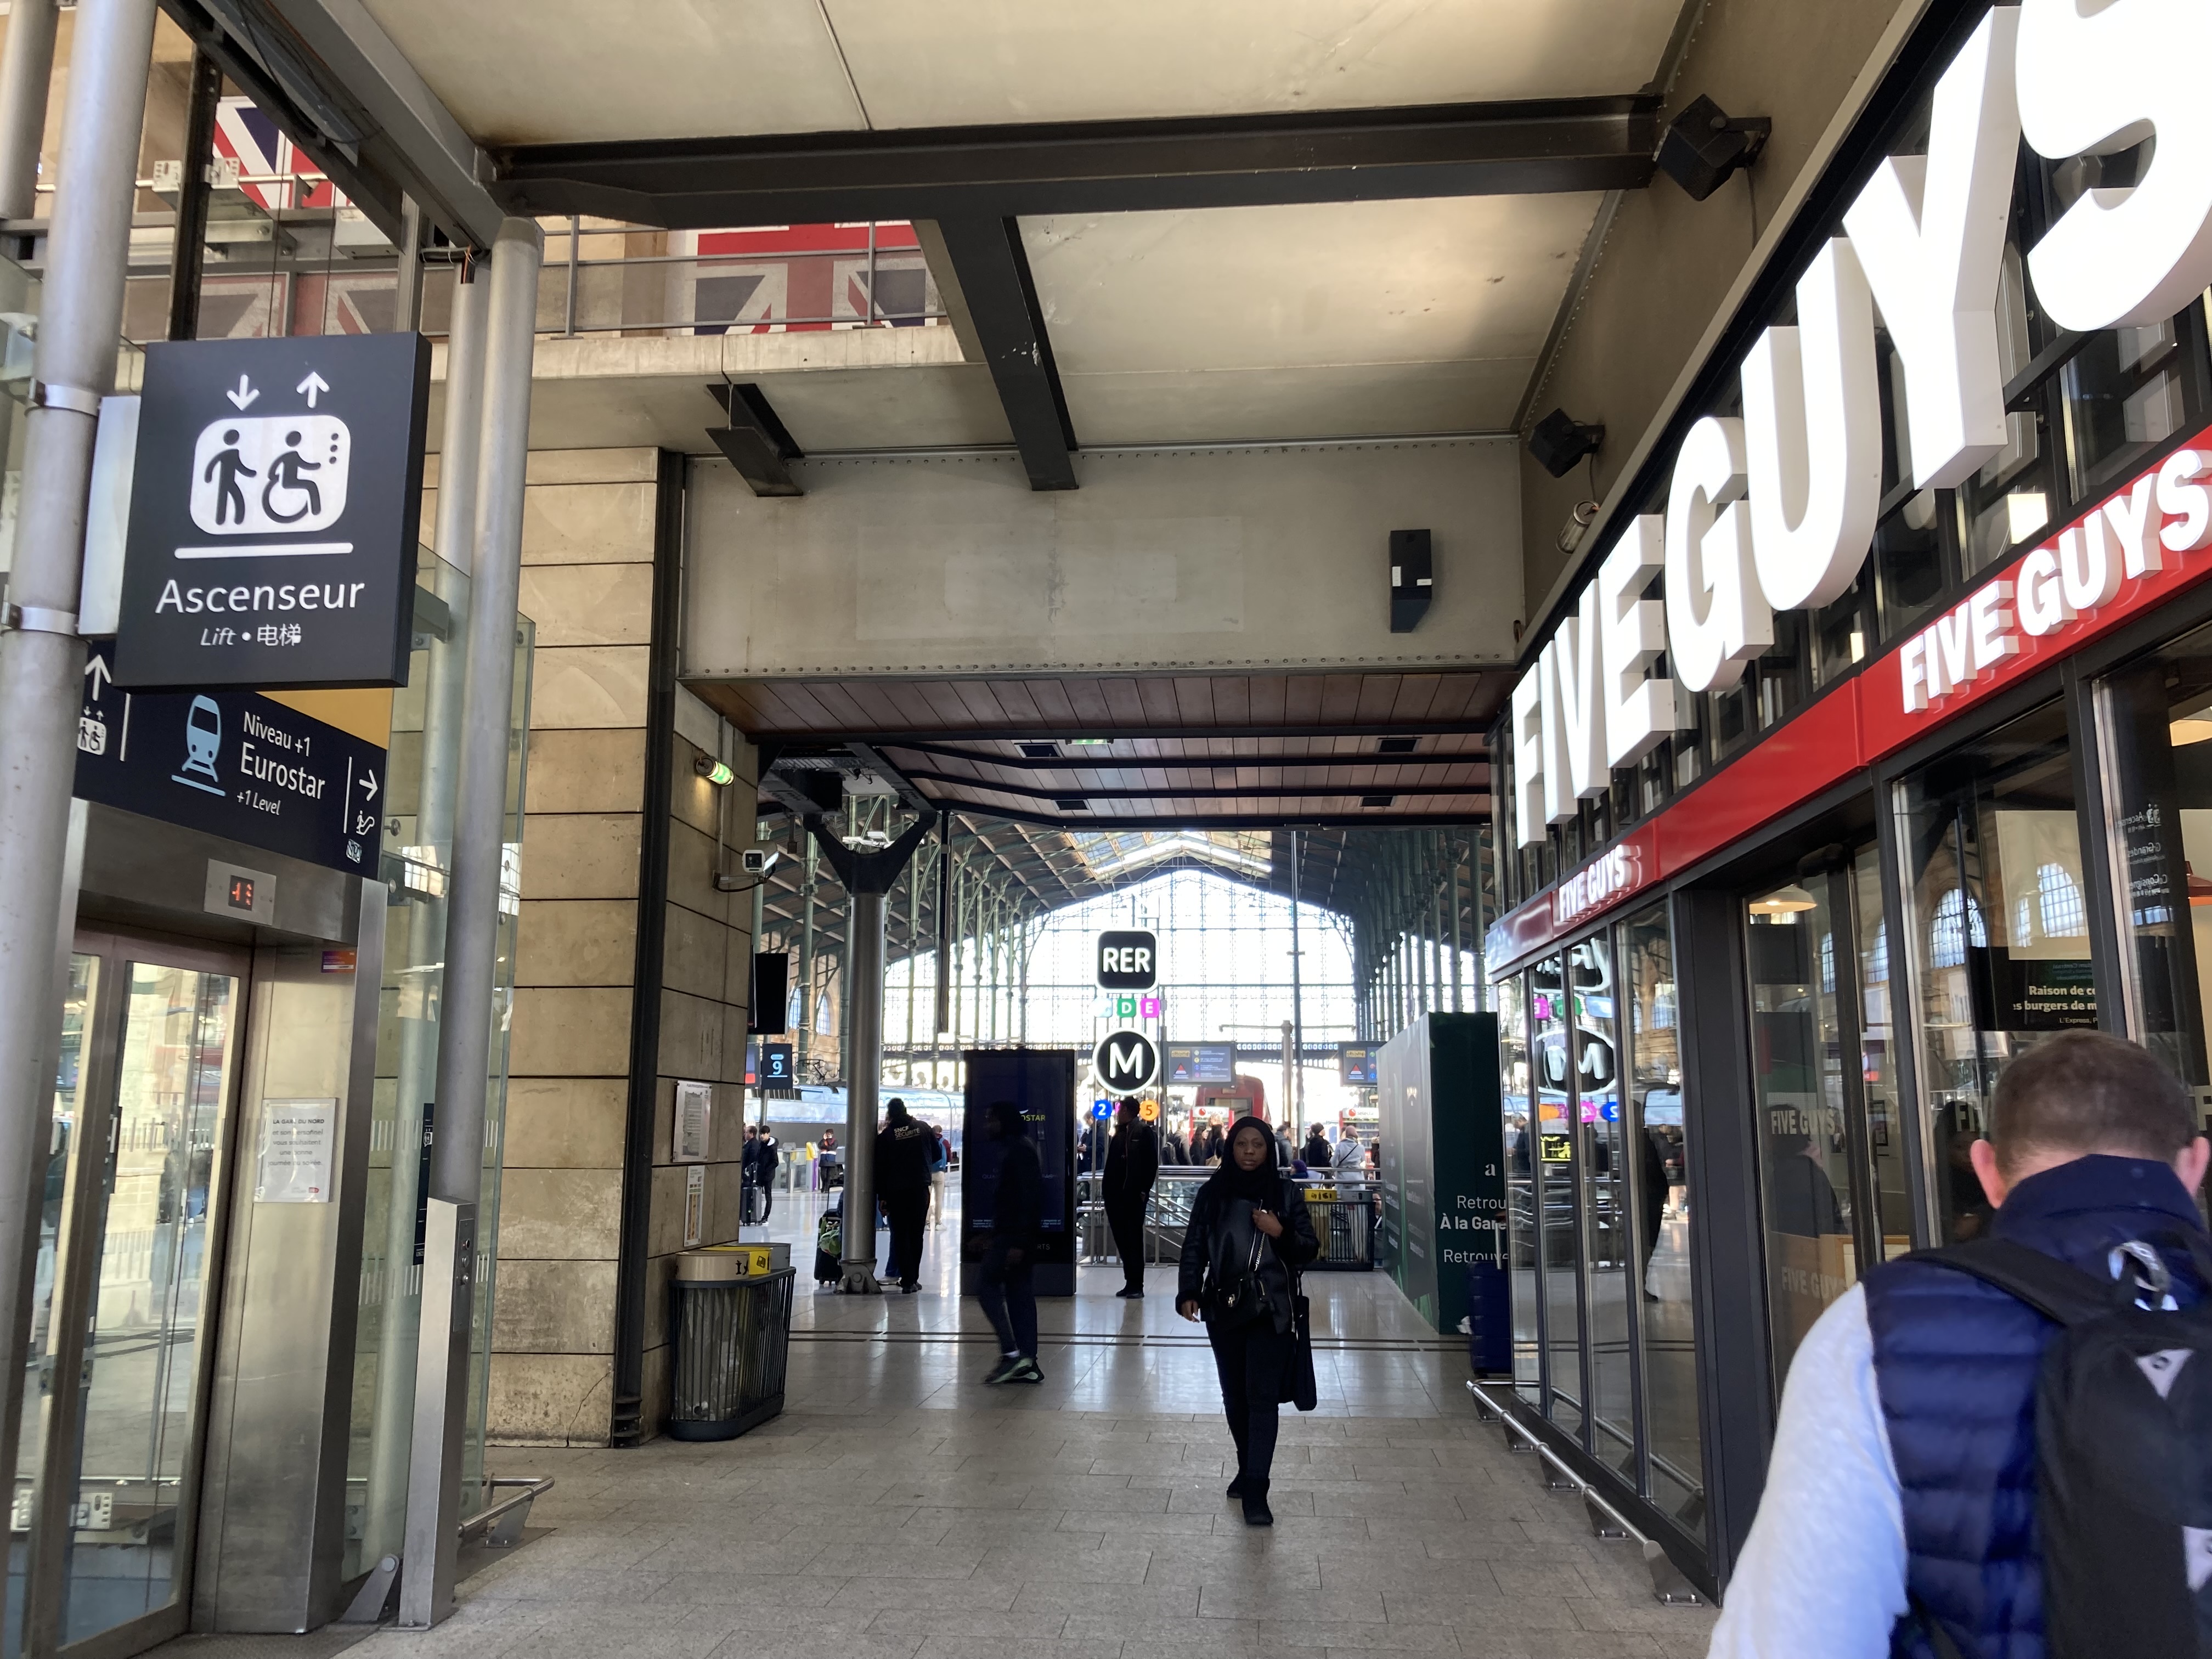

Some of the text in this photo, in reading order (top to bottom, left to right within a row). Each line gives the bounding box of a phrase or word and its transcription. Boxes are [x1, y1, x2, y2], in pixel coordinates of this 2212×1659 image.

[1512, 0, 2212, 849] FIVE GUYS
[1900, 450, 2212, 713] FIVE GUYS
[155, 579, 365, 614] Ascenseur
[200, 628, 236, 647] Lift
[257, 624, 301, 647] 电梯
[243, 711, 311, 757] Niveau +1
[240, 743, 325, 801] Eurostar
[236, 790, 280, 816] +1 Level
[1559, 845, 1632, 922] FIVE GUYS
[1102, 947, 1150, 973] RER
[2029, 985, 2067, 996] Raison
[2070, 985, 2084, 995] de
[1121, 1002, 1132, 1013] D
[1146, 1002, 1153, 1013] E
[2024, 1001, 2068, 1012] burgers
[2071, 1001, 2085, 1010] de
[772, 1061, 782, 1075] 9
[1109, 1042, 1143, 1079] M
[1098, 1104, 1153, 1116] 2 5
[1771, 1109, 1836, 1135] FIVE GUYS
[1457, 1195, 1506, 1209] Retrou
[1440, 1213, 1451, 1229] À
[1455, 1216, 1468, 1229] la
[1781, 1266, 1846, 1299] FIVE GUY
